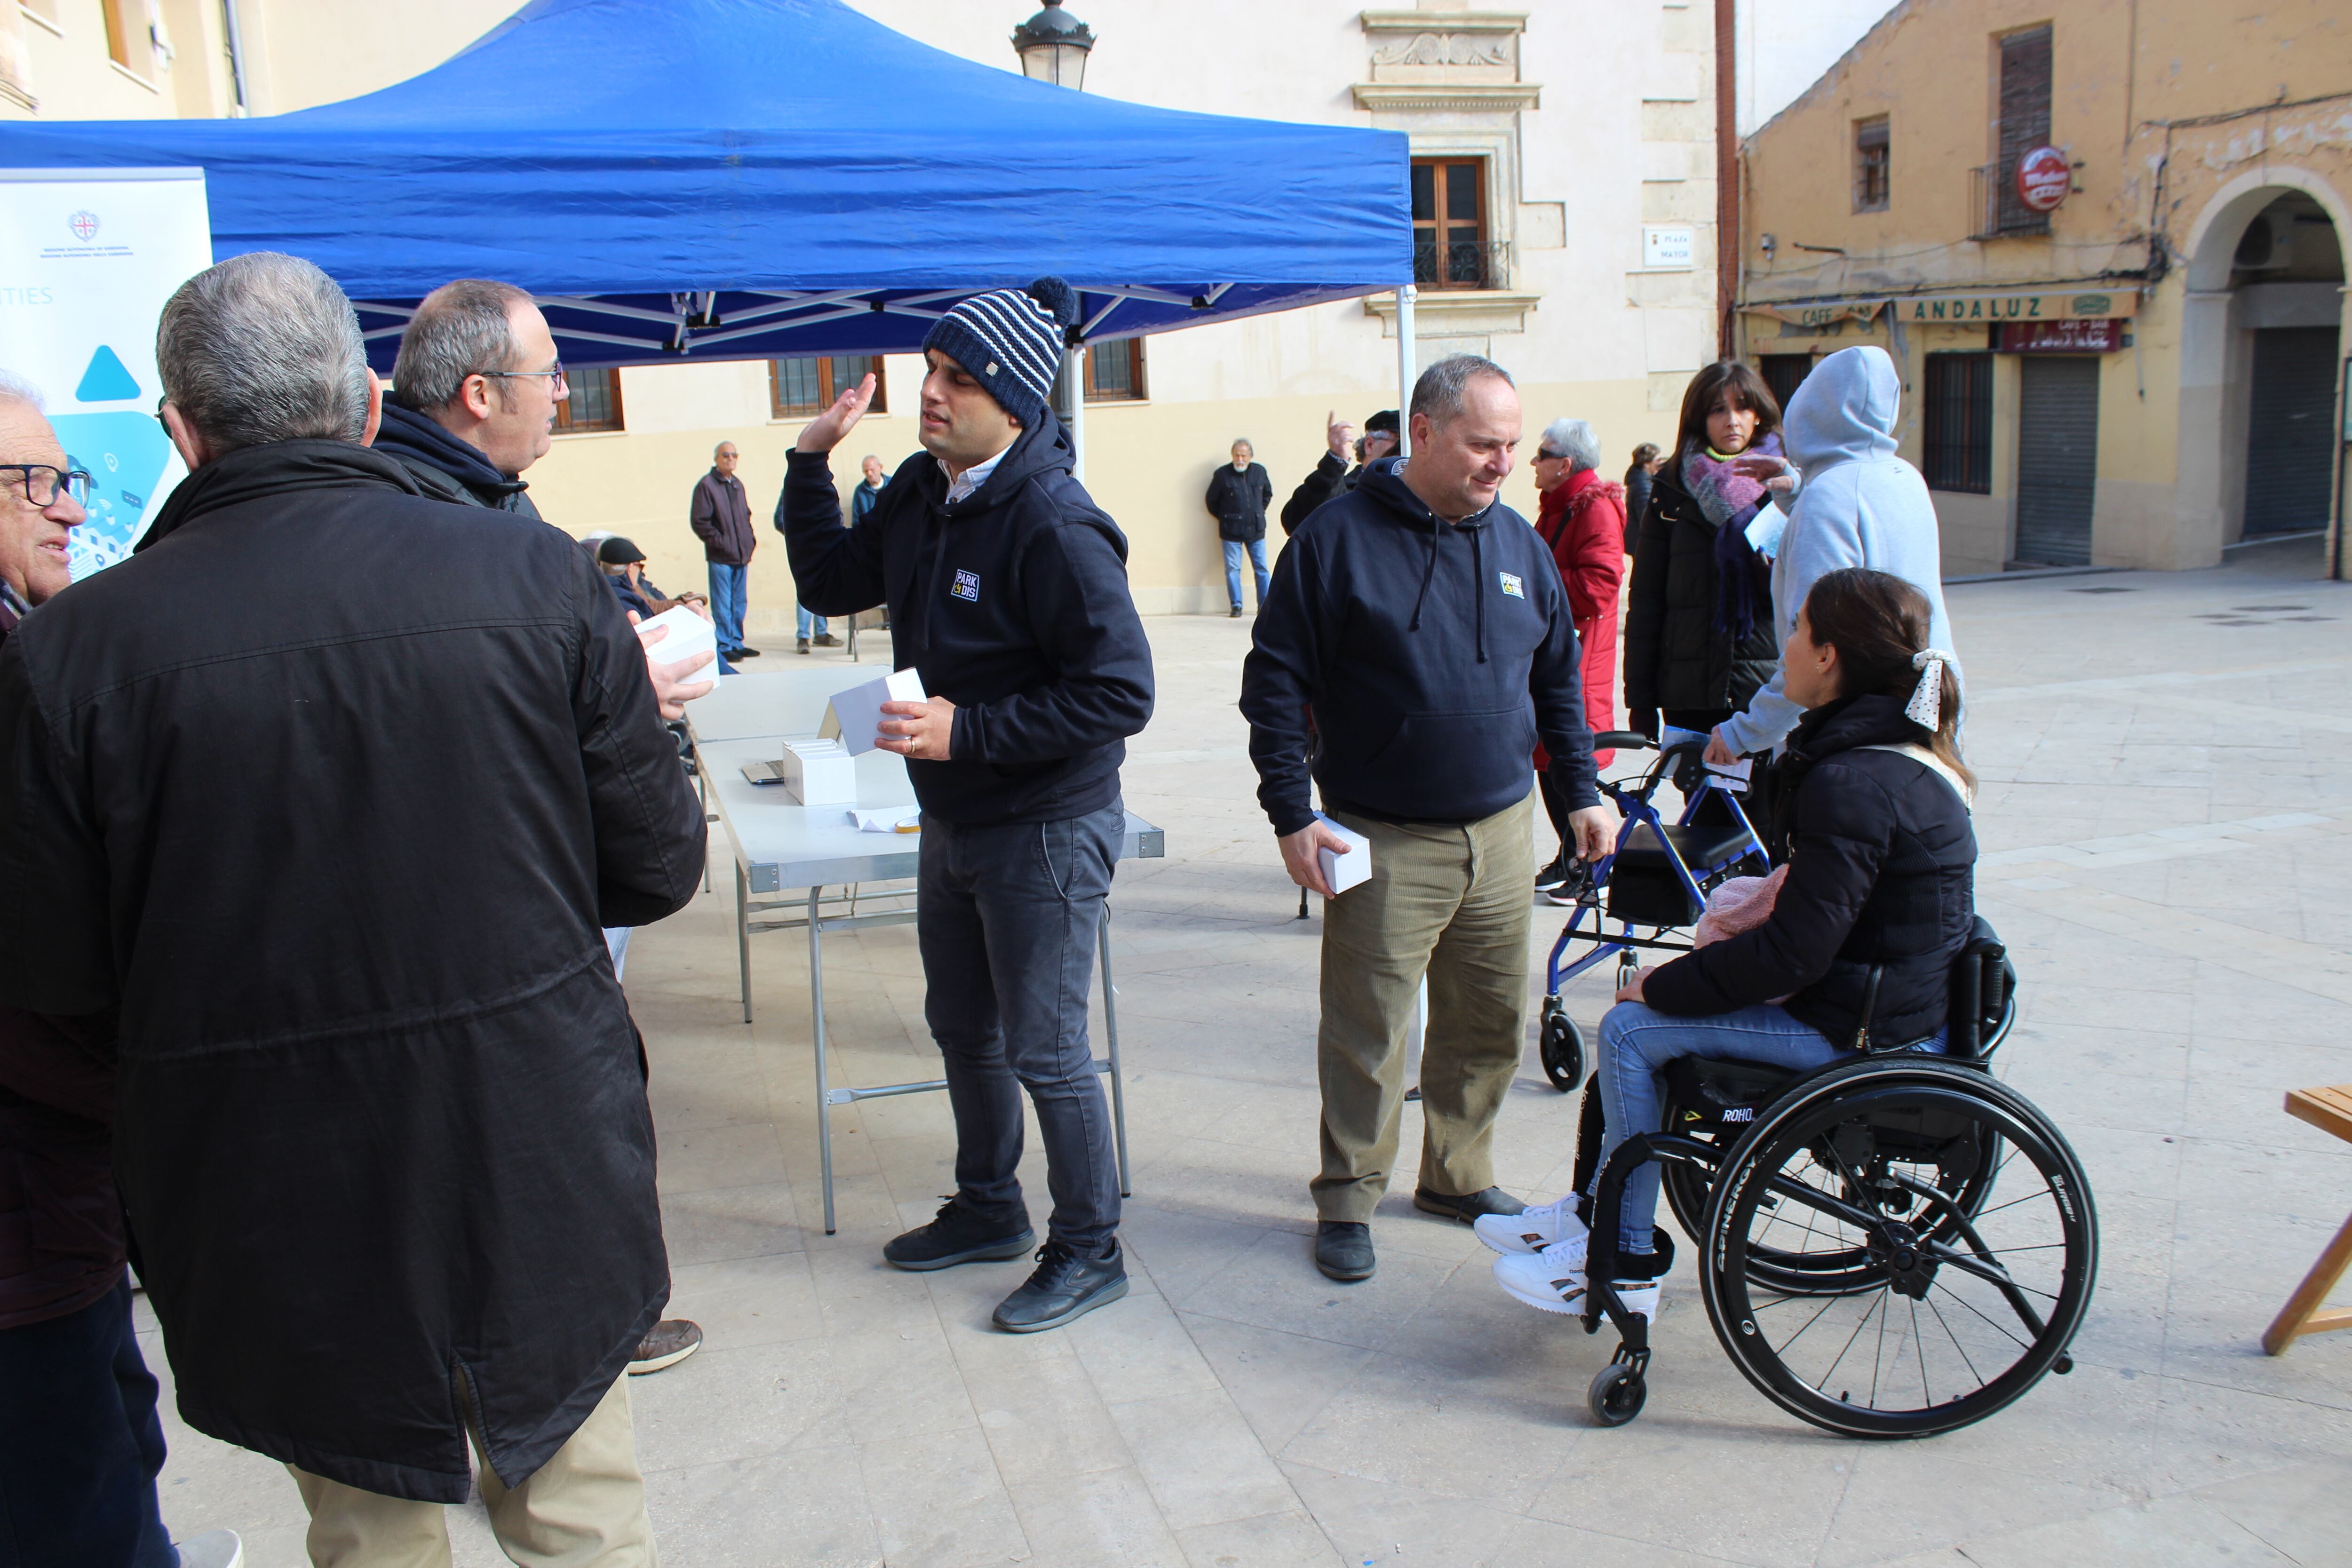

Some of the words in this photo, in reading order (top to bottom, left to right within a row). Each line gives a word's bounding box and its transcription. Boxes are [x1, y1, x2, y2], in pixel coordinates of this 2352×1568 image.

[1915, 297, 2040, 319] ANDALUZ
[956, 572, 977, 588] PARK
[1502, 574, 1520, 588] PARK
[961, 585, 976, 598] DIS
[1722, 1108, 1753, 1122] ROHO
